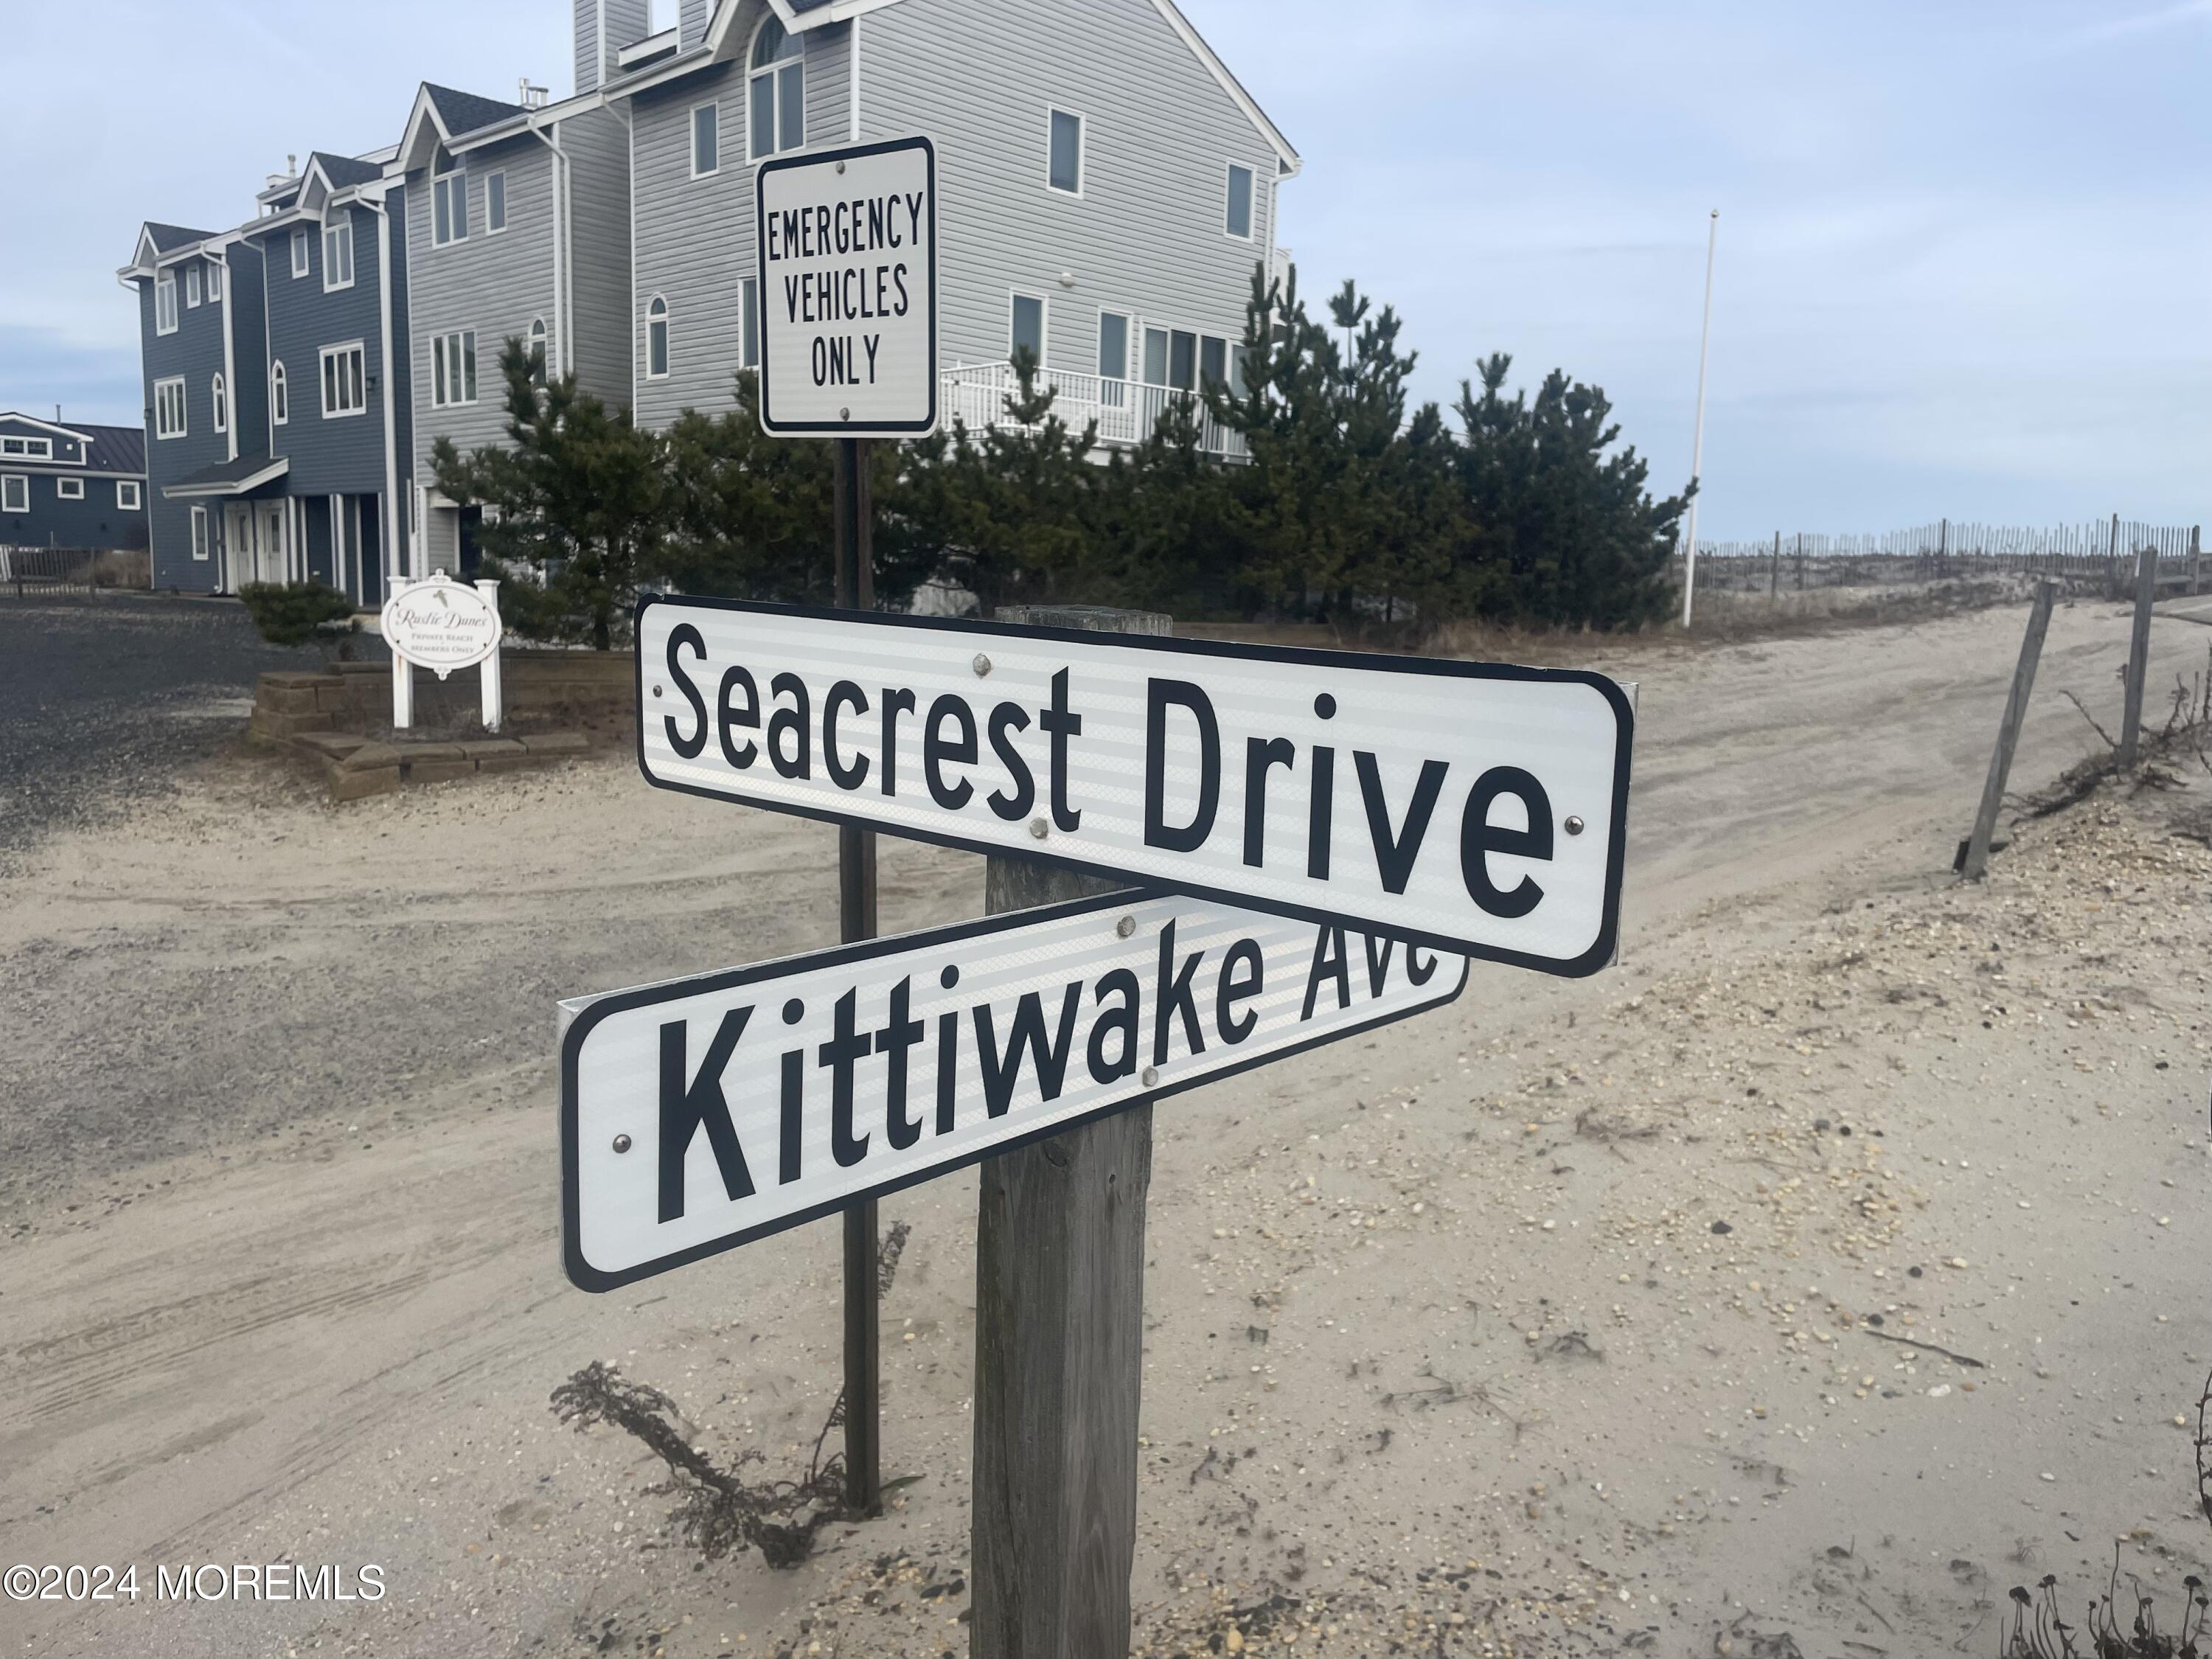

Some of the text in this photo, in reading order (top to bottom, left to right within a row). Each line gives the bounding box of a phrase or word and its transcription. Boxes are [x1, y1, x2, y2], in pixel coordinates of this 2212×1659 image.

[768, 192, 923, 261] EMERGENCY
[785, 262, 908, 323] VEHICLES
[812, 334, 880, 386] ONLY
[395, 609, 488, 629] Rustic Dunes
[664, 622, 1554, 919] Seacrest Drive
[658, 917, 1265, 1225] Kittiwake
